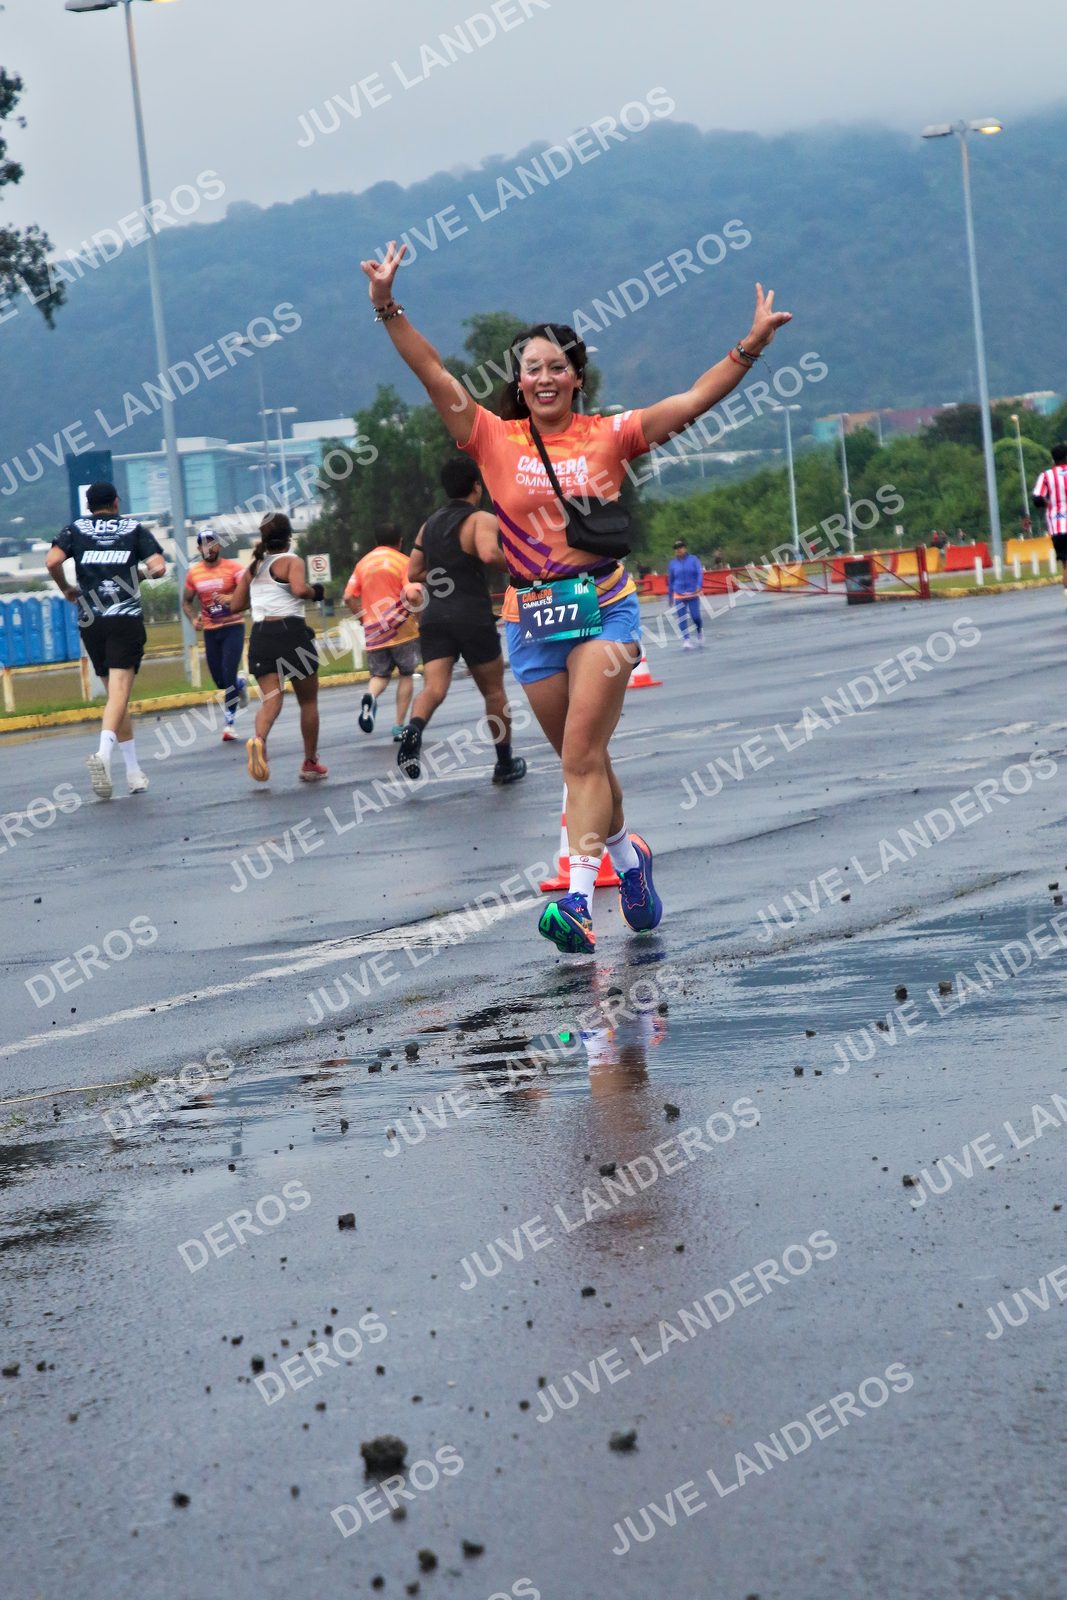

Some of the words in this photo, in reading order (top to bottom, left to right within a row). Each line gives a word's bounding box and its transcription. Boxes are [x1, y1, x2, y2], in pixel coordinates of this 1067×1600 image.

[517, 455, 588, 475] CARERA
[515, 473, 573, 487] OMNILFE
[532, 603, 579, 627] 1277
